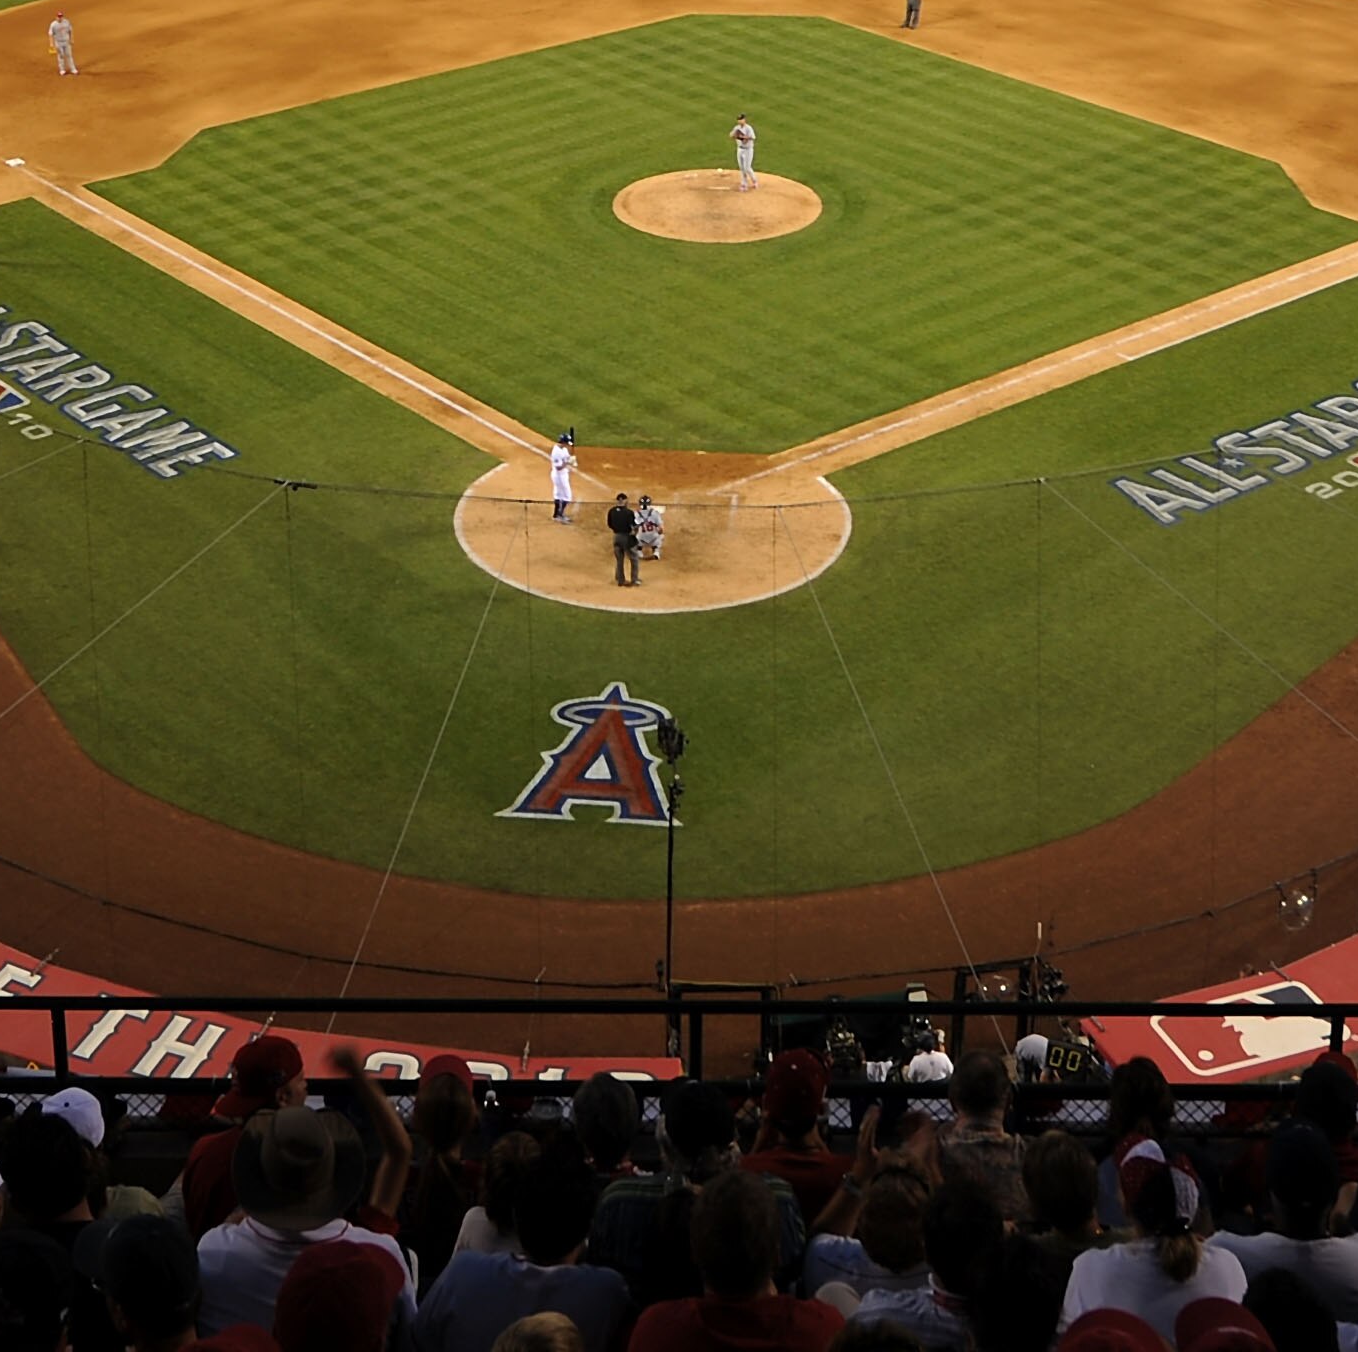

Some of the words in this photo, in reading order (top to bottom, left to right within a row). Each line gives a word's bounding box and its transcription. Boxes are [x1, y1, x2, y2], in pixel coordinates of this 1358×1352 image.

[59, 382, 240, 480] GAME
[493, 681, 684, 827] A
[66, 989, 232, 1082] TH
